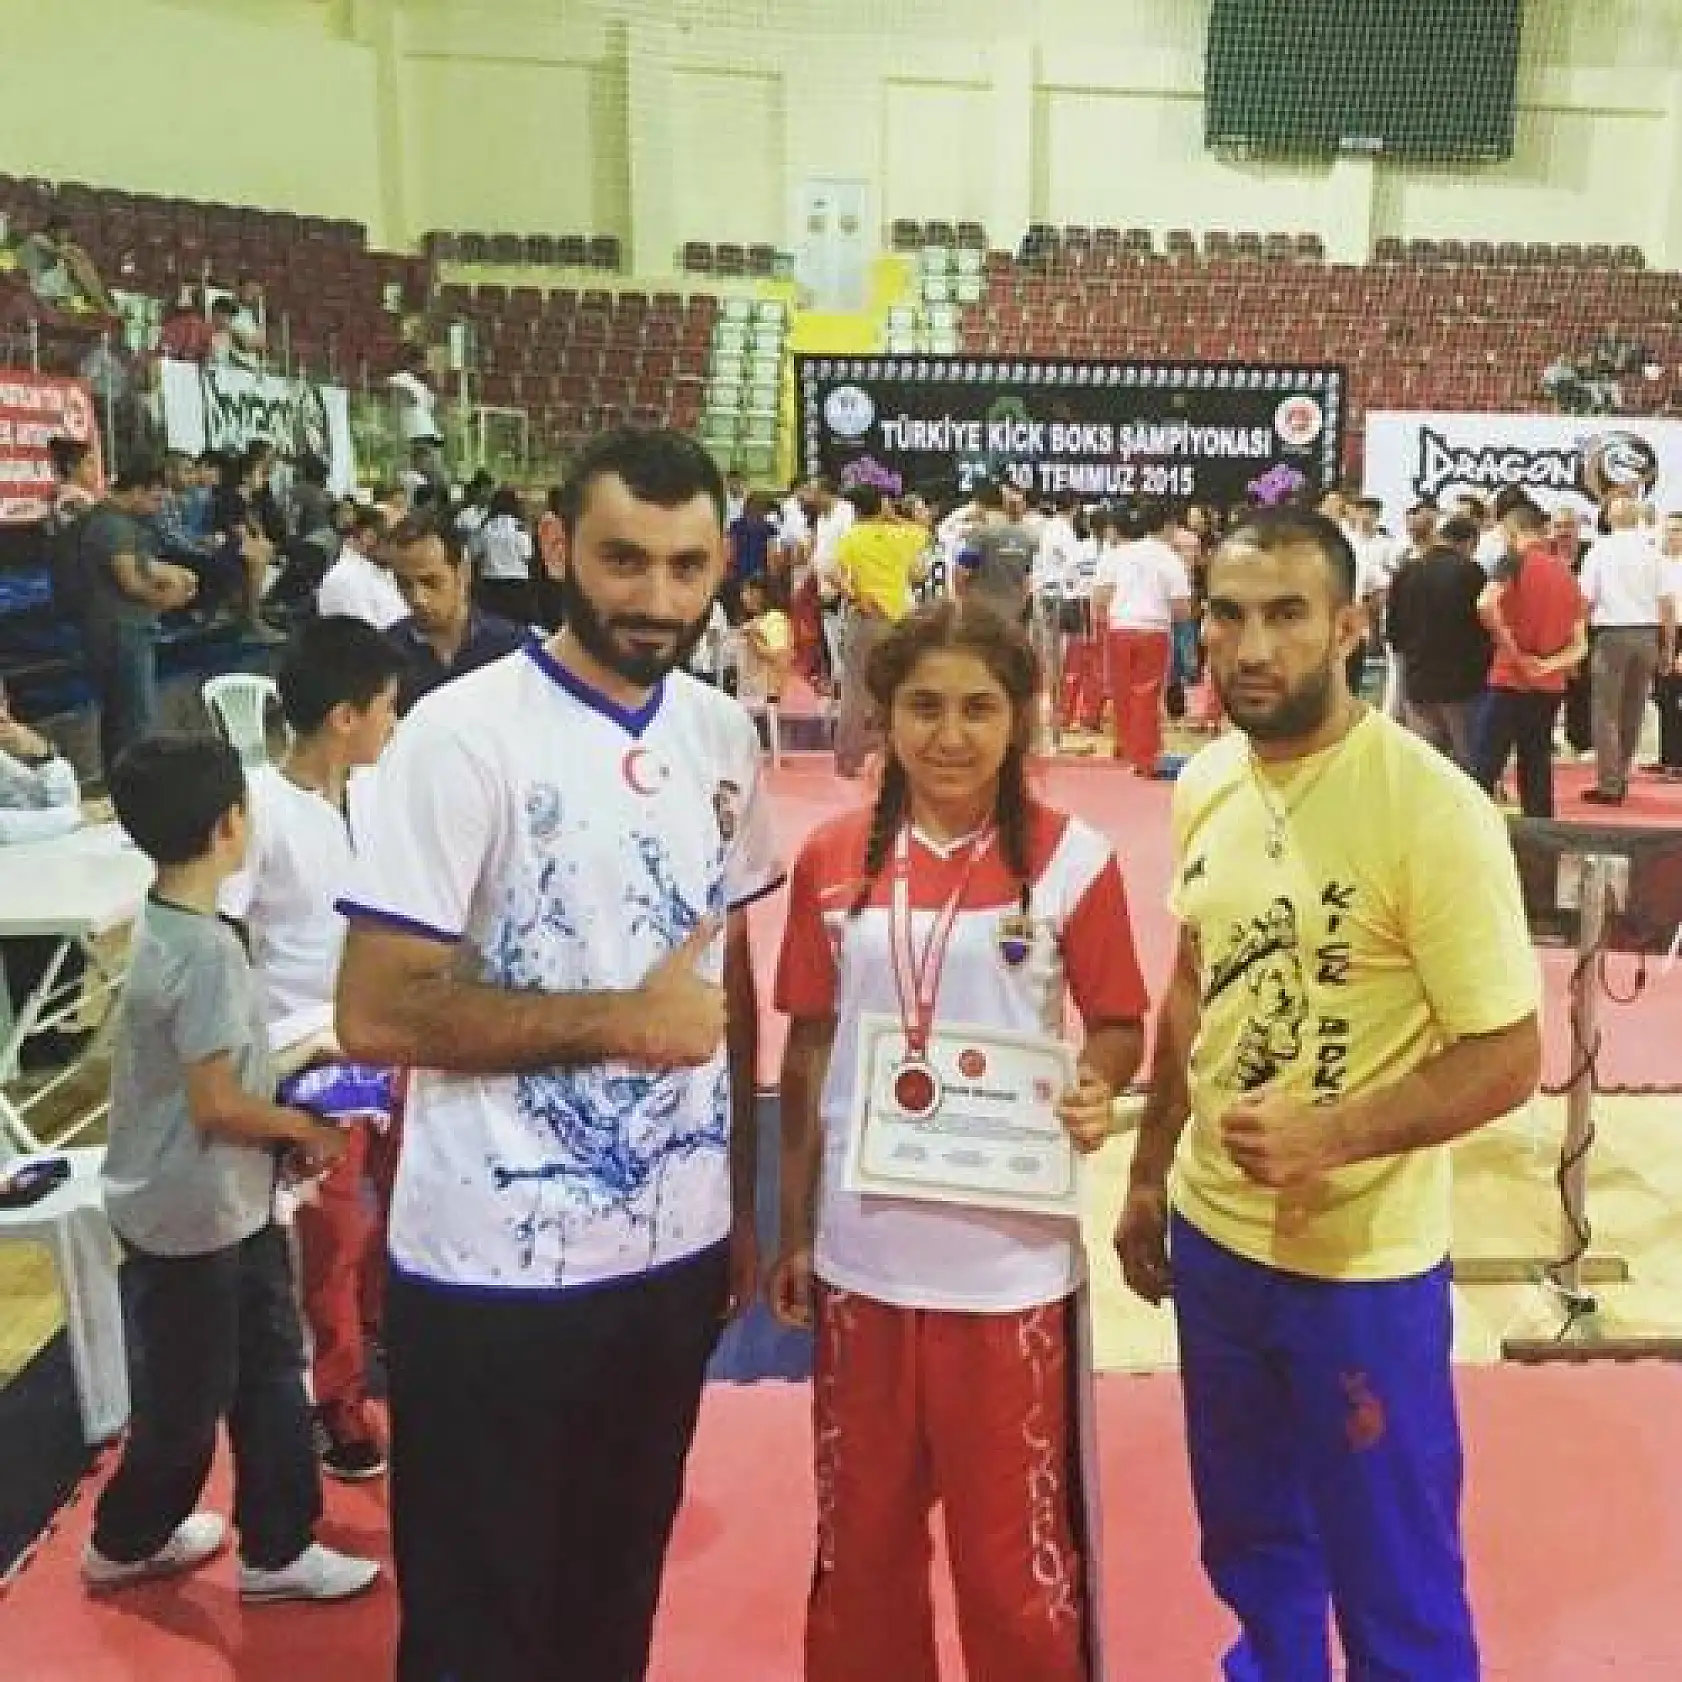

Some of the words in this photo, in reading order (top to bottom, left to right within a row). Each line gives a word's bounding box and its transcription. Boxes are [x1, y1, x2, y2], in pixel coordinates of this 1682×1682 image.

[880, 414, 982, 451] TÜRKİYE
[1051, 421, 1114, 455] BOKS
[1119, 420, 1273, 461] ŞAMPİYONASI
[1413, 424, 1580, 495] DRAGON
[1039, 462, 1135, 493] TEMMUZ
[1142, 464, 1195, 496] 2015
